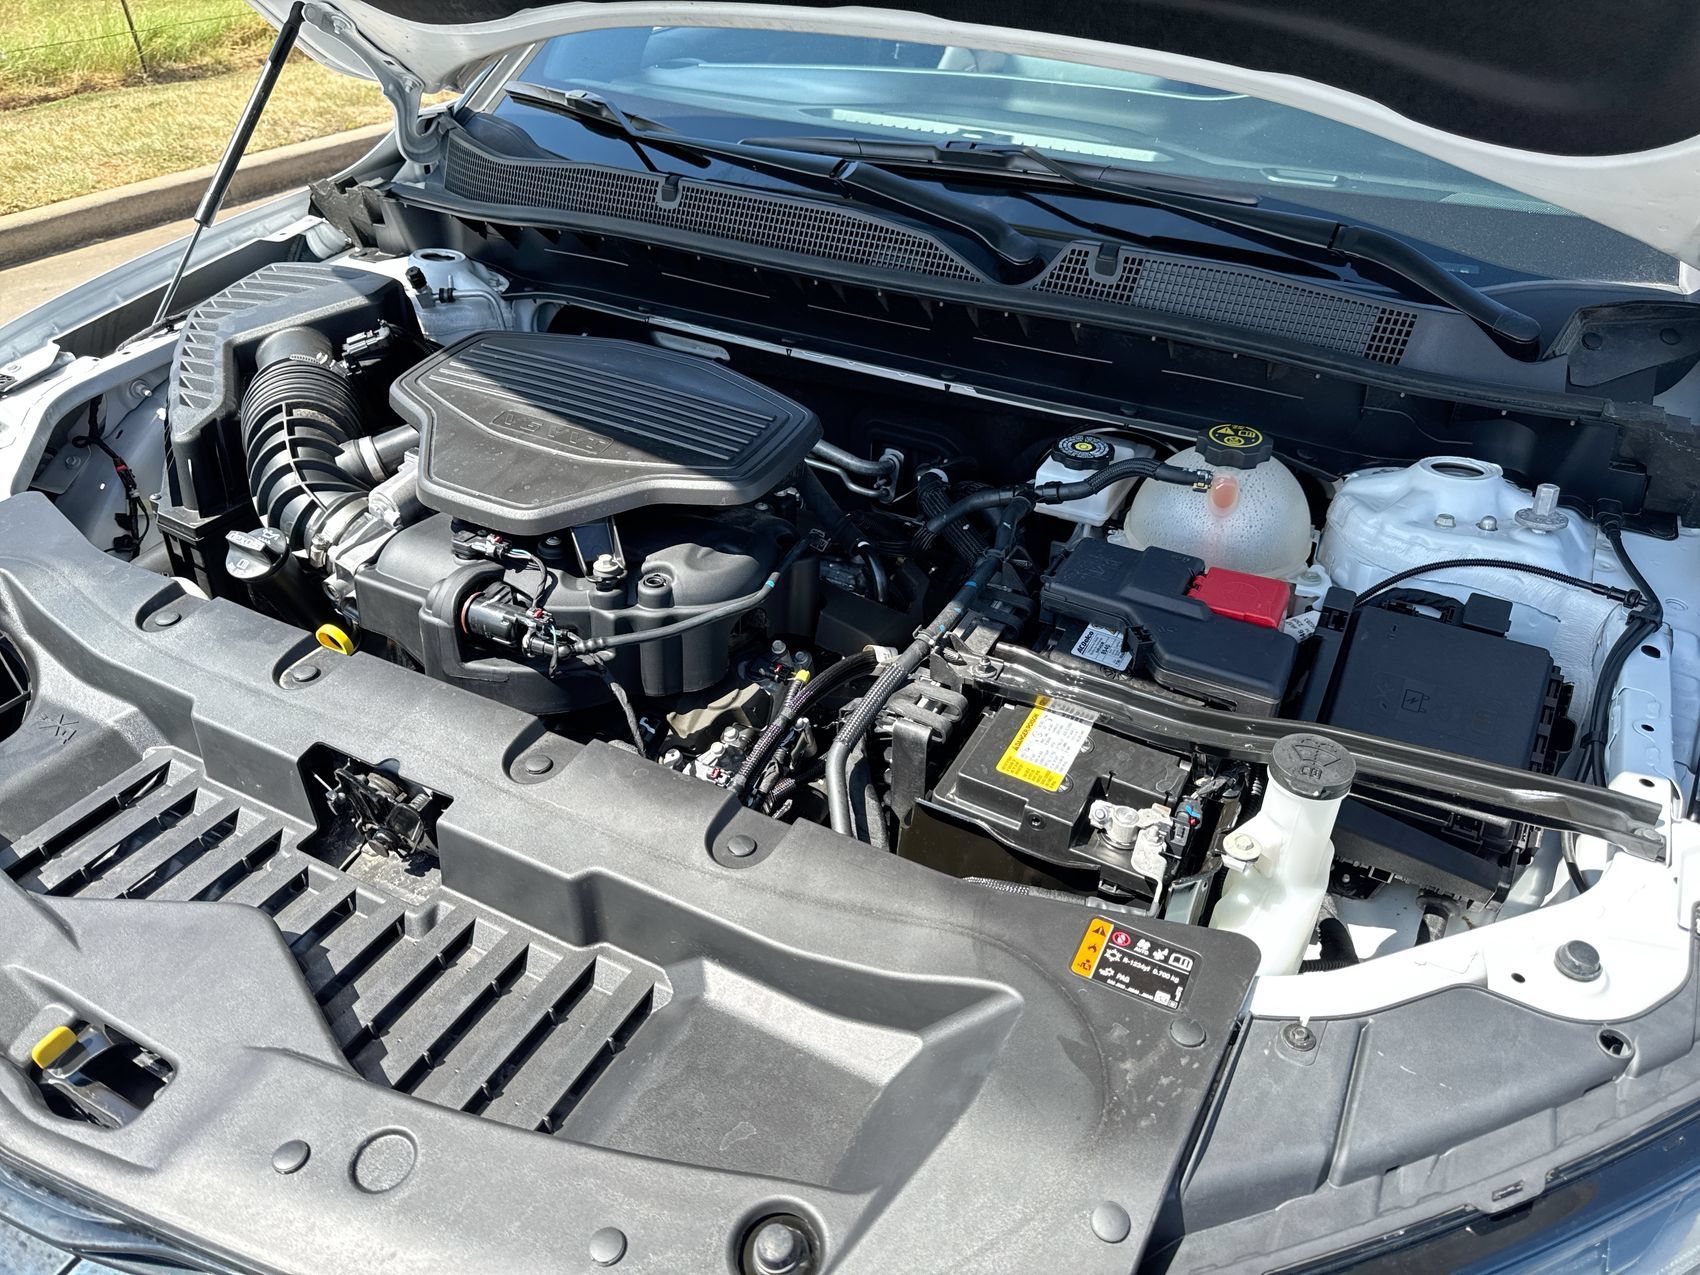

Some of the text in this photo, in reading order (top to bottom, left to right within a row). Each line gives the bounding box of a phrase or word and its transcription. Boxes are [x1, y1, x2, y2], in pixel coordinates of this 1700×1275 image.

[1076, 630, 1094, 654] ACDelco
[1116, 973, 1130, 984] PAG
[1152, 966, 1171, 981] 0.700
[1170, 973, 1180, 984] kg
